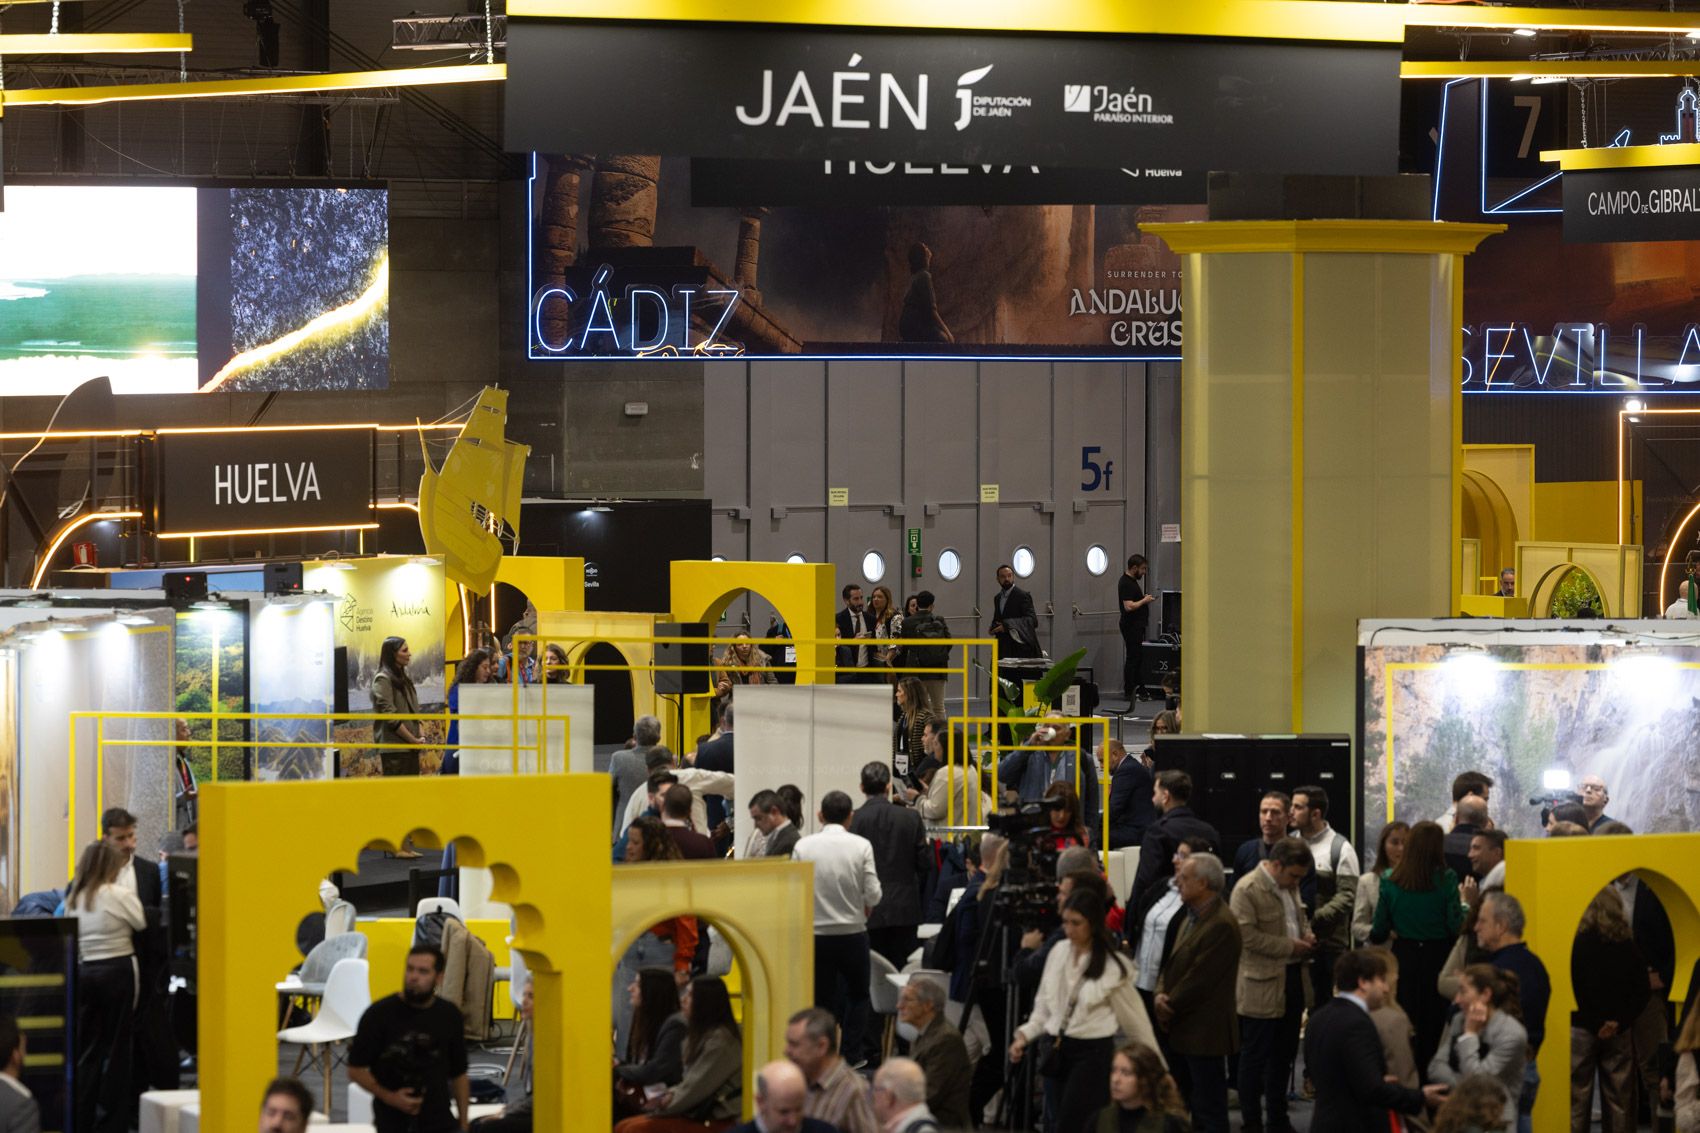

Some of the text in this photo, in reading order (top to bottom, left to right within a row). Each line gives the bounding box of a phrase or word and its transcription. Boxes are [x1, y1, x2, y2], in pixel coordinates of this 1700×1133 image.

[736, 53, 928, 130] JAÉN
[973, 96, 1031, 107] DIPUTACIÓN
[1094, 86, 1152, 113] Jaén
[973, 106, 1012, 117] DE JAÉN
[1094, 112, 1173, 124] PARAÍSO INTERIOR
[1513, 96, 1541, 159] 7
[1588, 188, 1700, 215] CAMPO DE GIBRAL
[1107, 270, 1166, 278] SURRENDER
[536, 269, 739, 351] CÁDIZ
[1069, 288, 1183, 317] ANDALU
[1081, 446, 1113, 492] 5f
[215, 462, 321, 505] HUELVA
